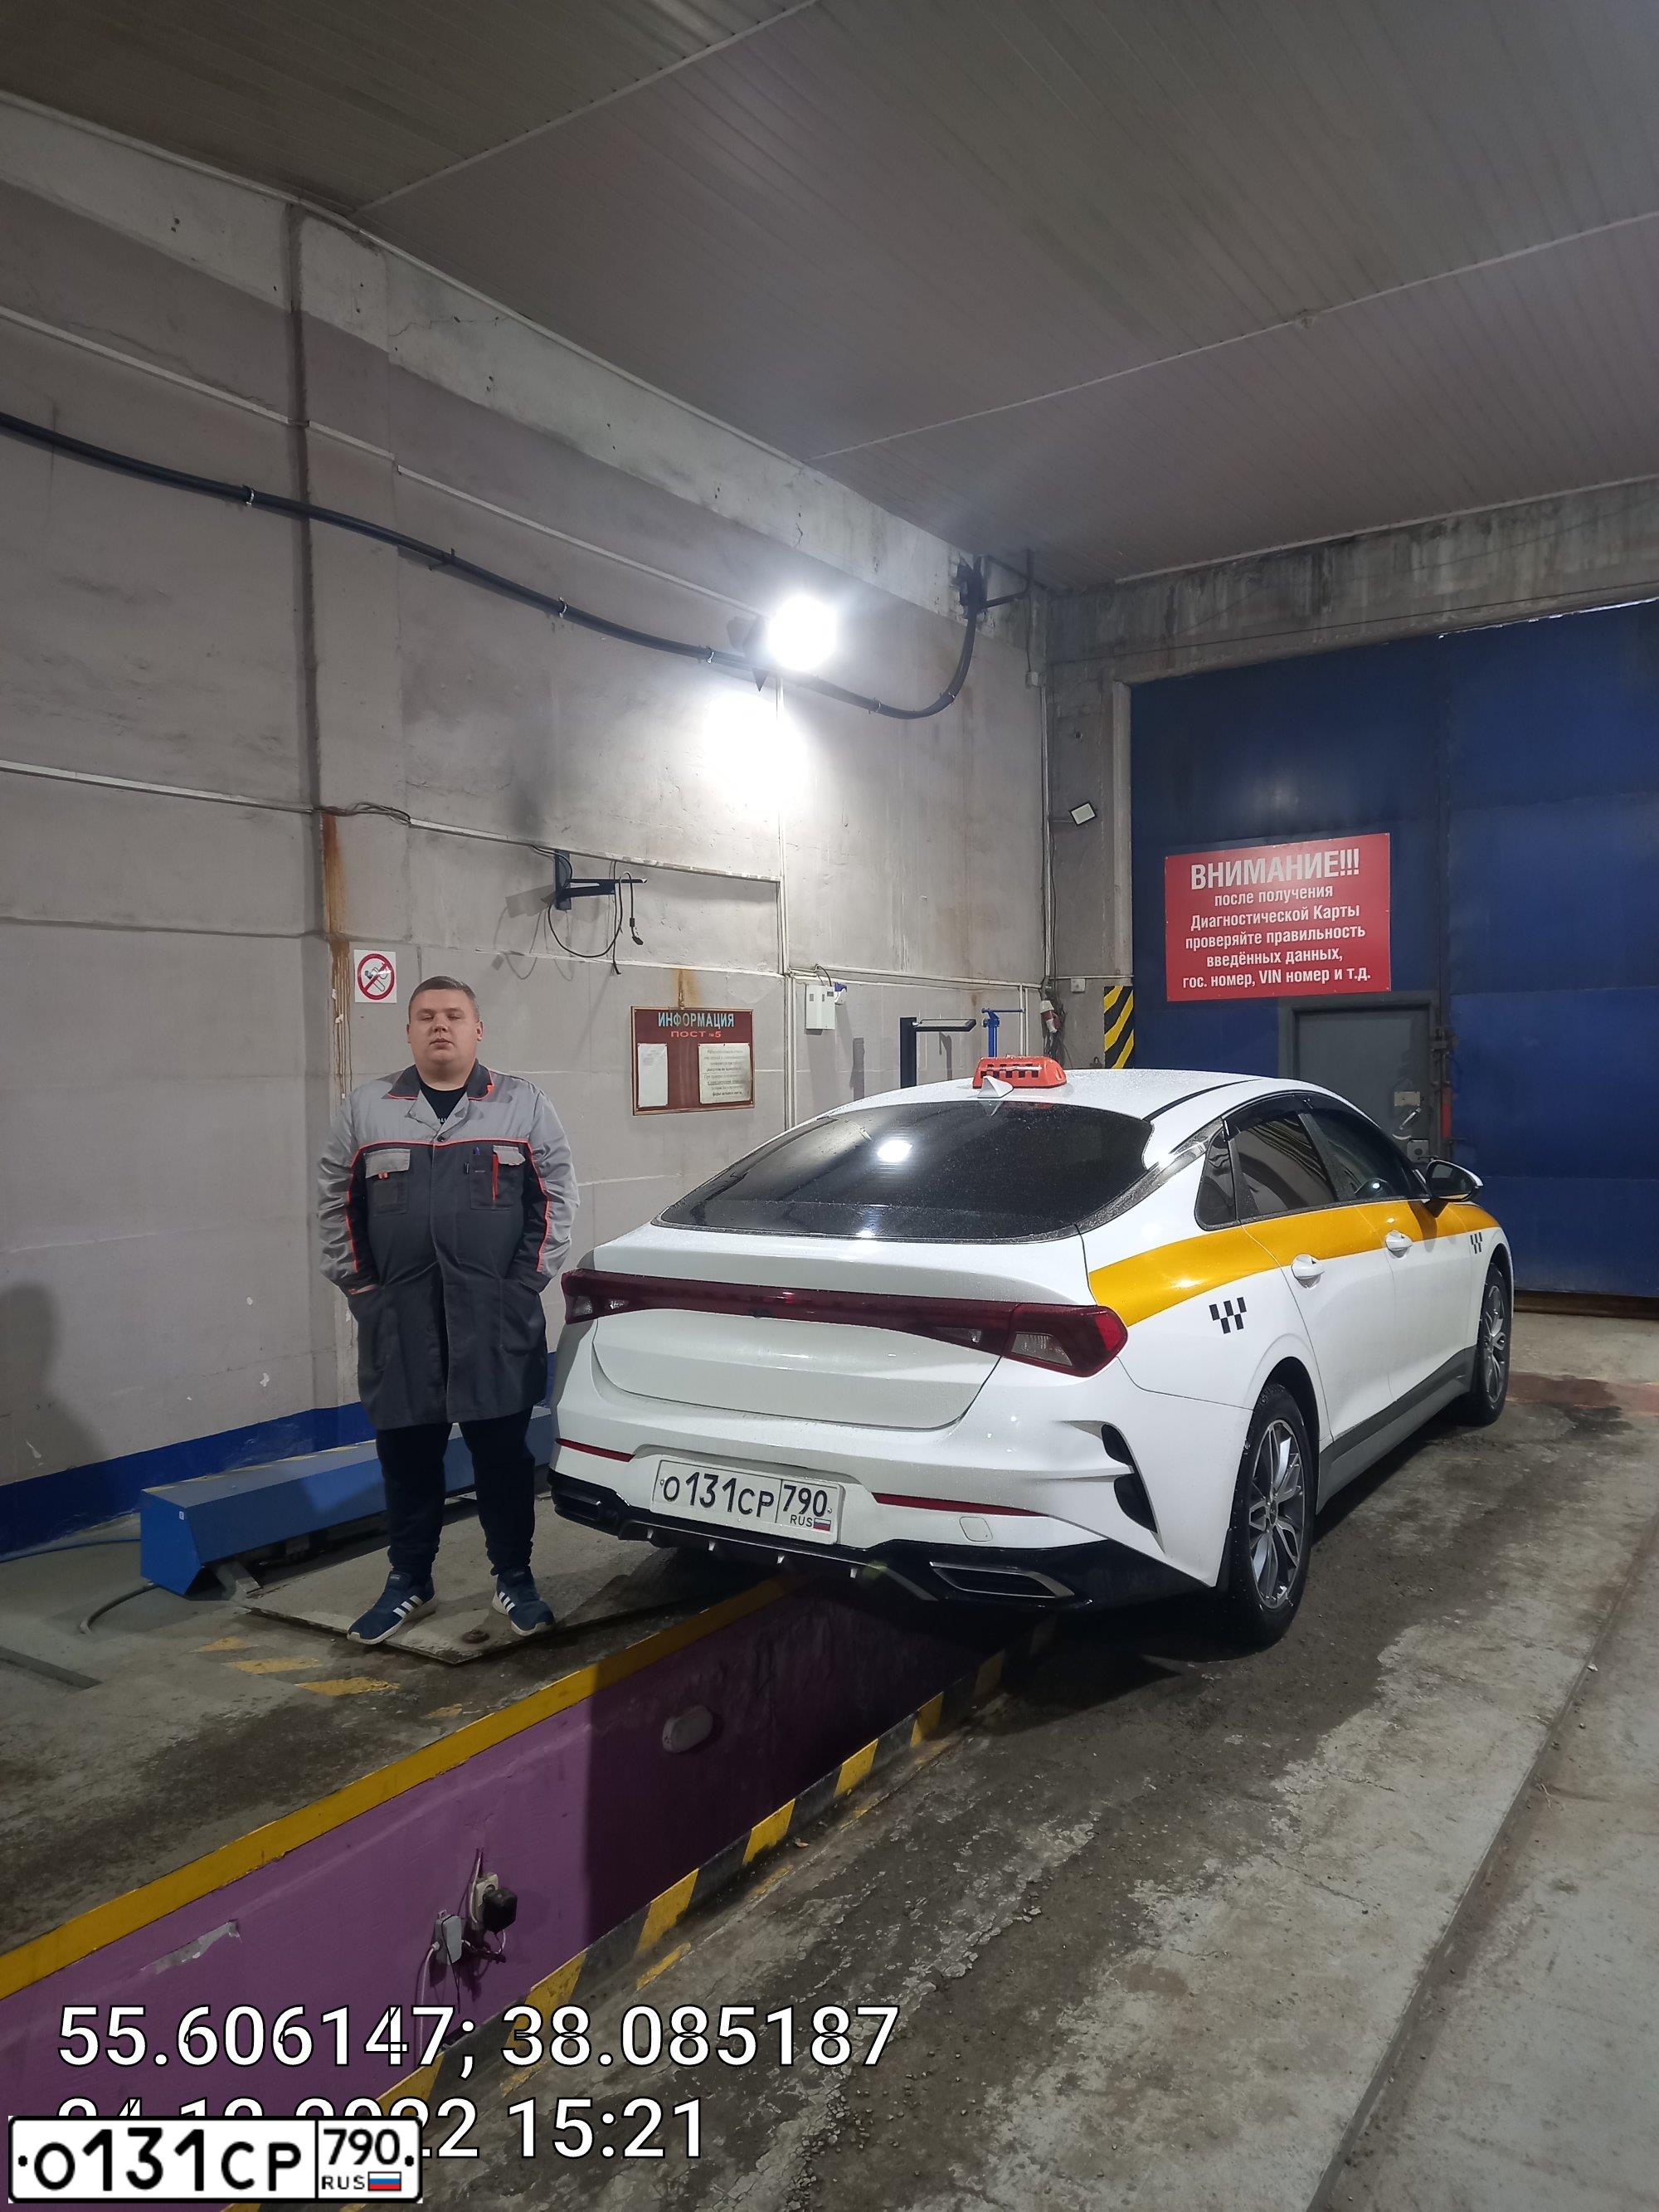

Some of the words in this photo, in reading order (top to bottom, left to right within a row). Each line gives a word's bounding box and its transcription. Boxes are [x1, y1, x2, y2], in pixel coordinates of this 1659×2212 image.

[1190, 848, 1360, 890] ВНИМАНИЕ!!!
[1214, 892, 1254, 907] после
[1258, 885, 1333, 904] получения
[1190, 908, 1309, 931] Диагностической
[1313, 904, 1360, 922] Карты
[1185, 930, 1262, 950] проверяйте
[1266, 925, 1365, 946] правильность
[1206, 951, 1282, 968] введённых
[1285, 947, 1343, 964] данных,
[1182, 977, 1207, 989] гос.
[1210, 972, 1256, 988] номер,
[1259, 970, 1282, 984] VIN
[1286, 969, 1330, 984] номер
[1334, 968, 1342, 980] и
[1346, 967, 1371, 982] т.д.
[658, 1011, 735, 1030] ИНФОРМАЦИЯ
[670, 1030, 707, 1038] ПОСТ
[783, 1484, 828, 1518] 790
[790, 1514, 813, 1527] RUS
